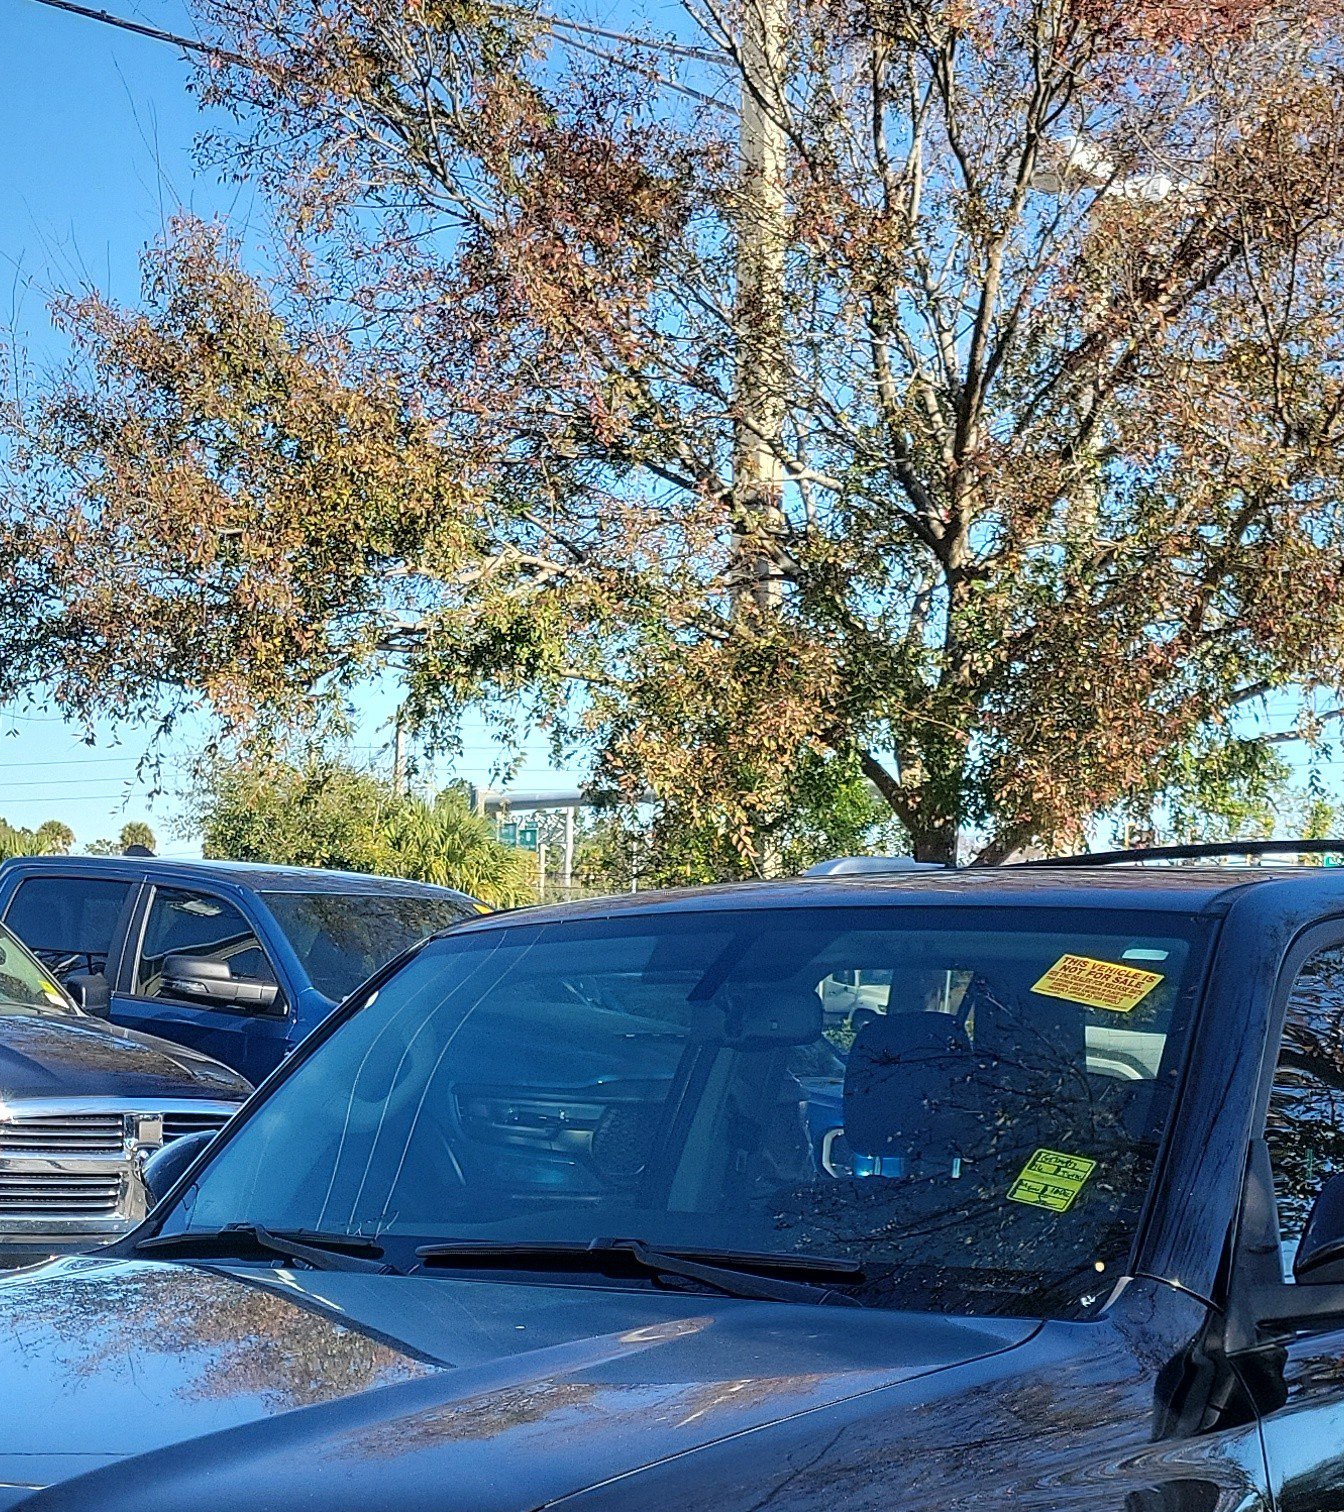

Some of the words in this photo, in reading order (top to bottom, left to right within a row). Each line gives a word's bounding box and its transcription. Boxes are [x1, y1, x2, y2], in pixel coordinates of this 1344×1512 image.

[1058, 964, 1087, 976] NOT
[1085, 970, 1112, 982] FOR
[1111, 976, 1145, 989] SALE
[1062, 956, 1090, 969] THIS
[1091, 961, 1142, 980] VEHICLE
[1142, 975, 1157, 984] IS
